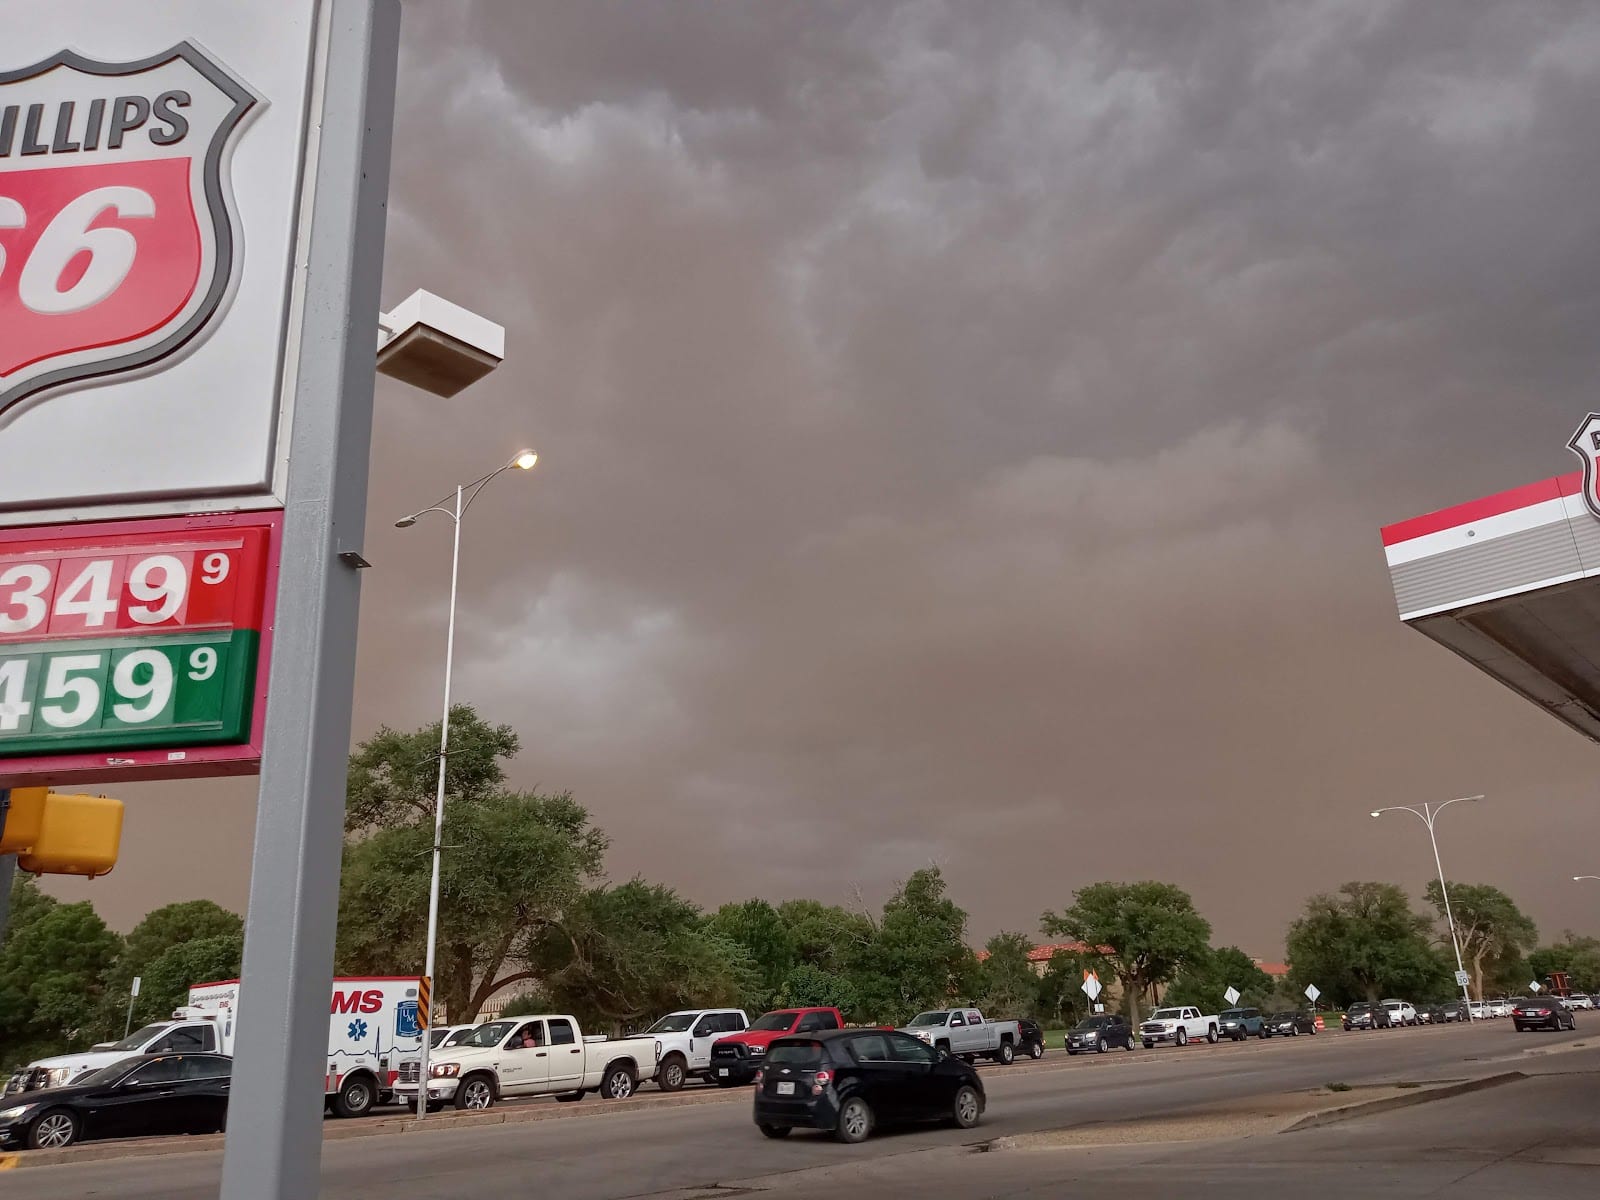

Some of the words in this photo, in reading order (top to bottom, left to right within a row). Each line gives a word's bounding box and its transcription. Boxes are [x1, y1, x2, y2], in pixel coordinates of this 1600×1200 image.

[0, 185, 156, 315] 6
[0, 554, 188, 634] 349
[201, 552, 230, 585] 9
[187, 646, 218, 681] 9
[330, 989, 384, 1014] MS
